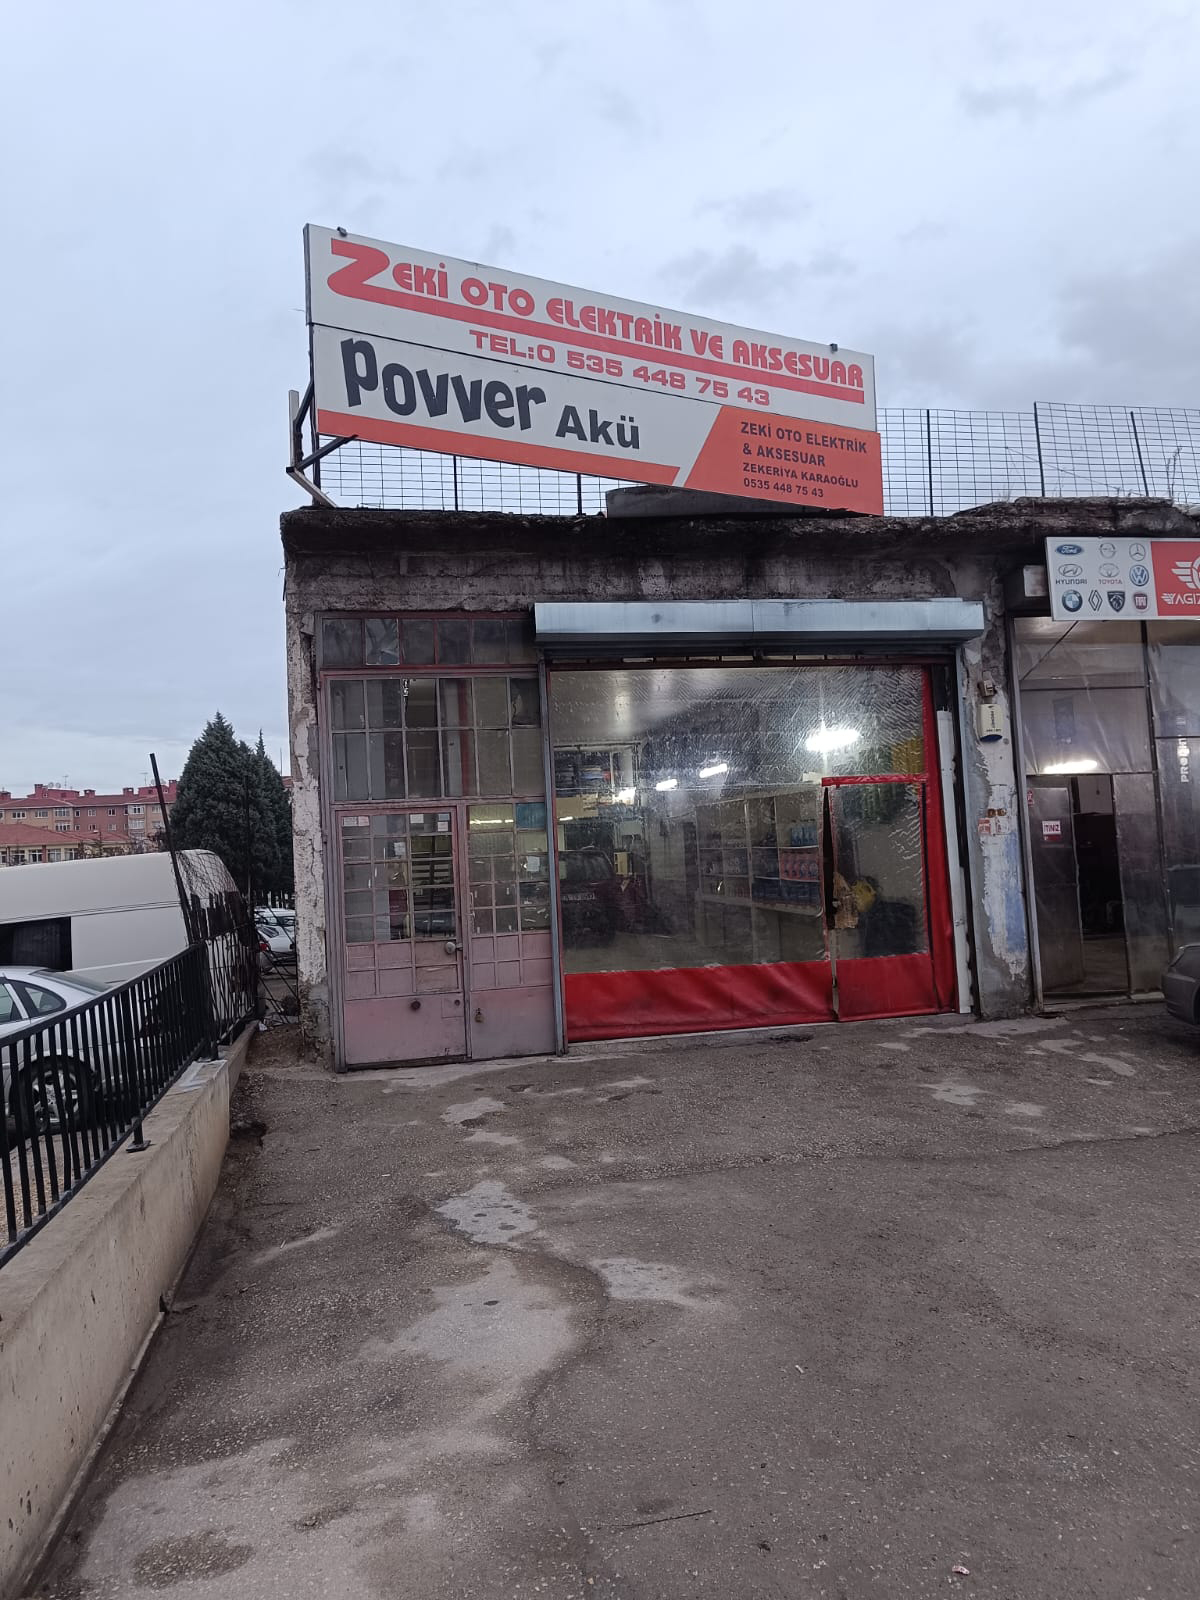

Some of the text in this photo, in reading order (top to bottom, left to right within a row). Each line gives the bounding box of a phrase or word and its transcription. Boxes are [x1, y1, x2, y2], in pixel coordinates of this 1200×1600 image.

[460, 277, 535, 316] OTO
[546, 298, 682, 350] ELEKTRİK
[690, 329, 723, 359] VE
[732, 340, 864, 388] AKSESUAR
[566, 350, 623, 377] 535
[633, 365, 686, 390] 448
[696, 377, 728, 398] 75
[737, 387, 770, 406] 43
[555, 405, 640, 449] Akü
[740, 421, 867, 453] ZEKİ OTO ELEKTRİK
[743, 442, 826, 467] & AKSESUAR
[743, 477, 824, 498] 0535 448 75 43
[801, 471, 859, 488] KARAOĞLU
